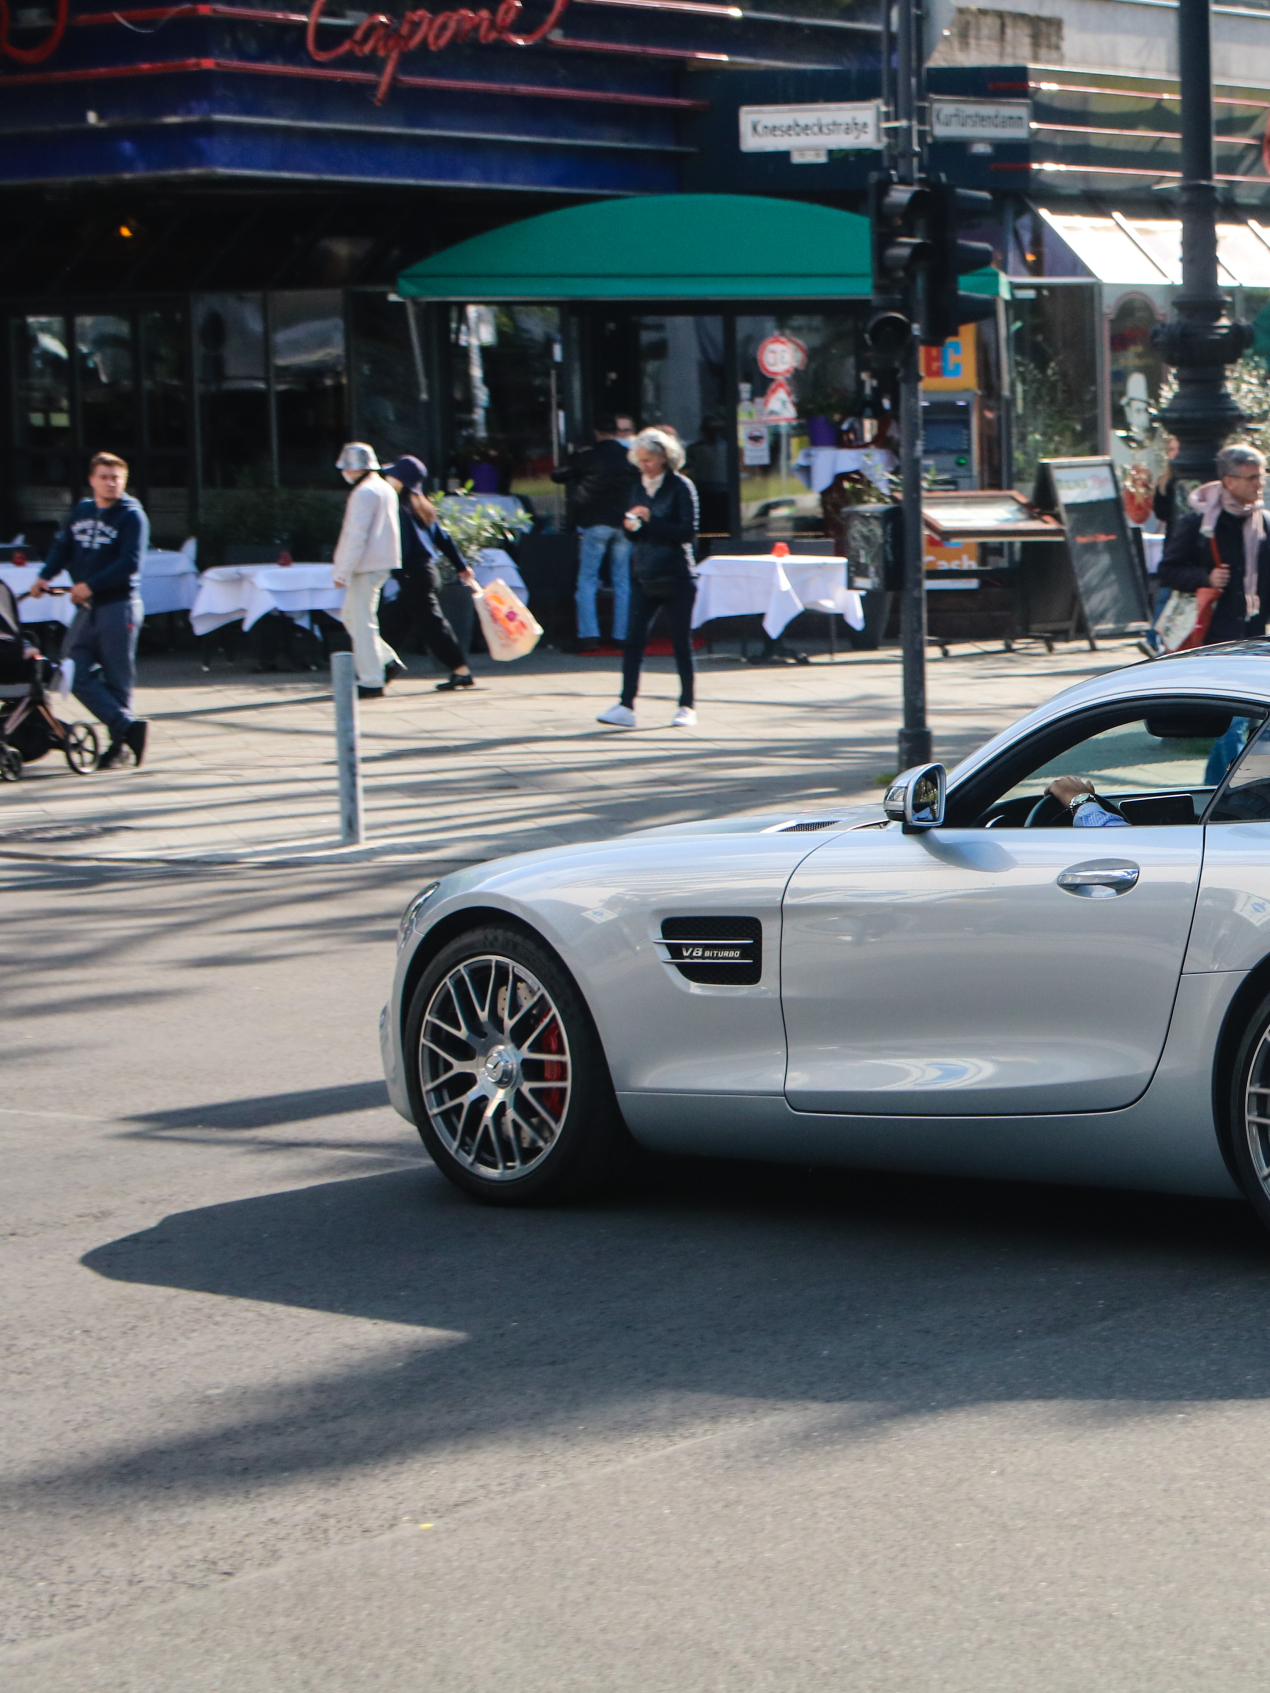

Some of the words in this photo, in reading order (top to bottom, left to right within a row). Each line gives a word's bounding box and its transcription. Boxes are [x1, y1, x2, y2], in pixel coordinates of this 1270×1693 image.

[751, 117, 868, 139] Knesebeckstraße
[934, 107, 1023, 129] Kurfürstendamm
[682, 947, 703, 957] V8
[704, 950, 741, 958] BITURBO
